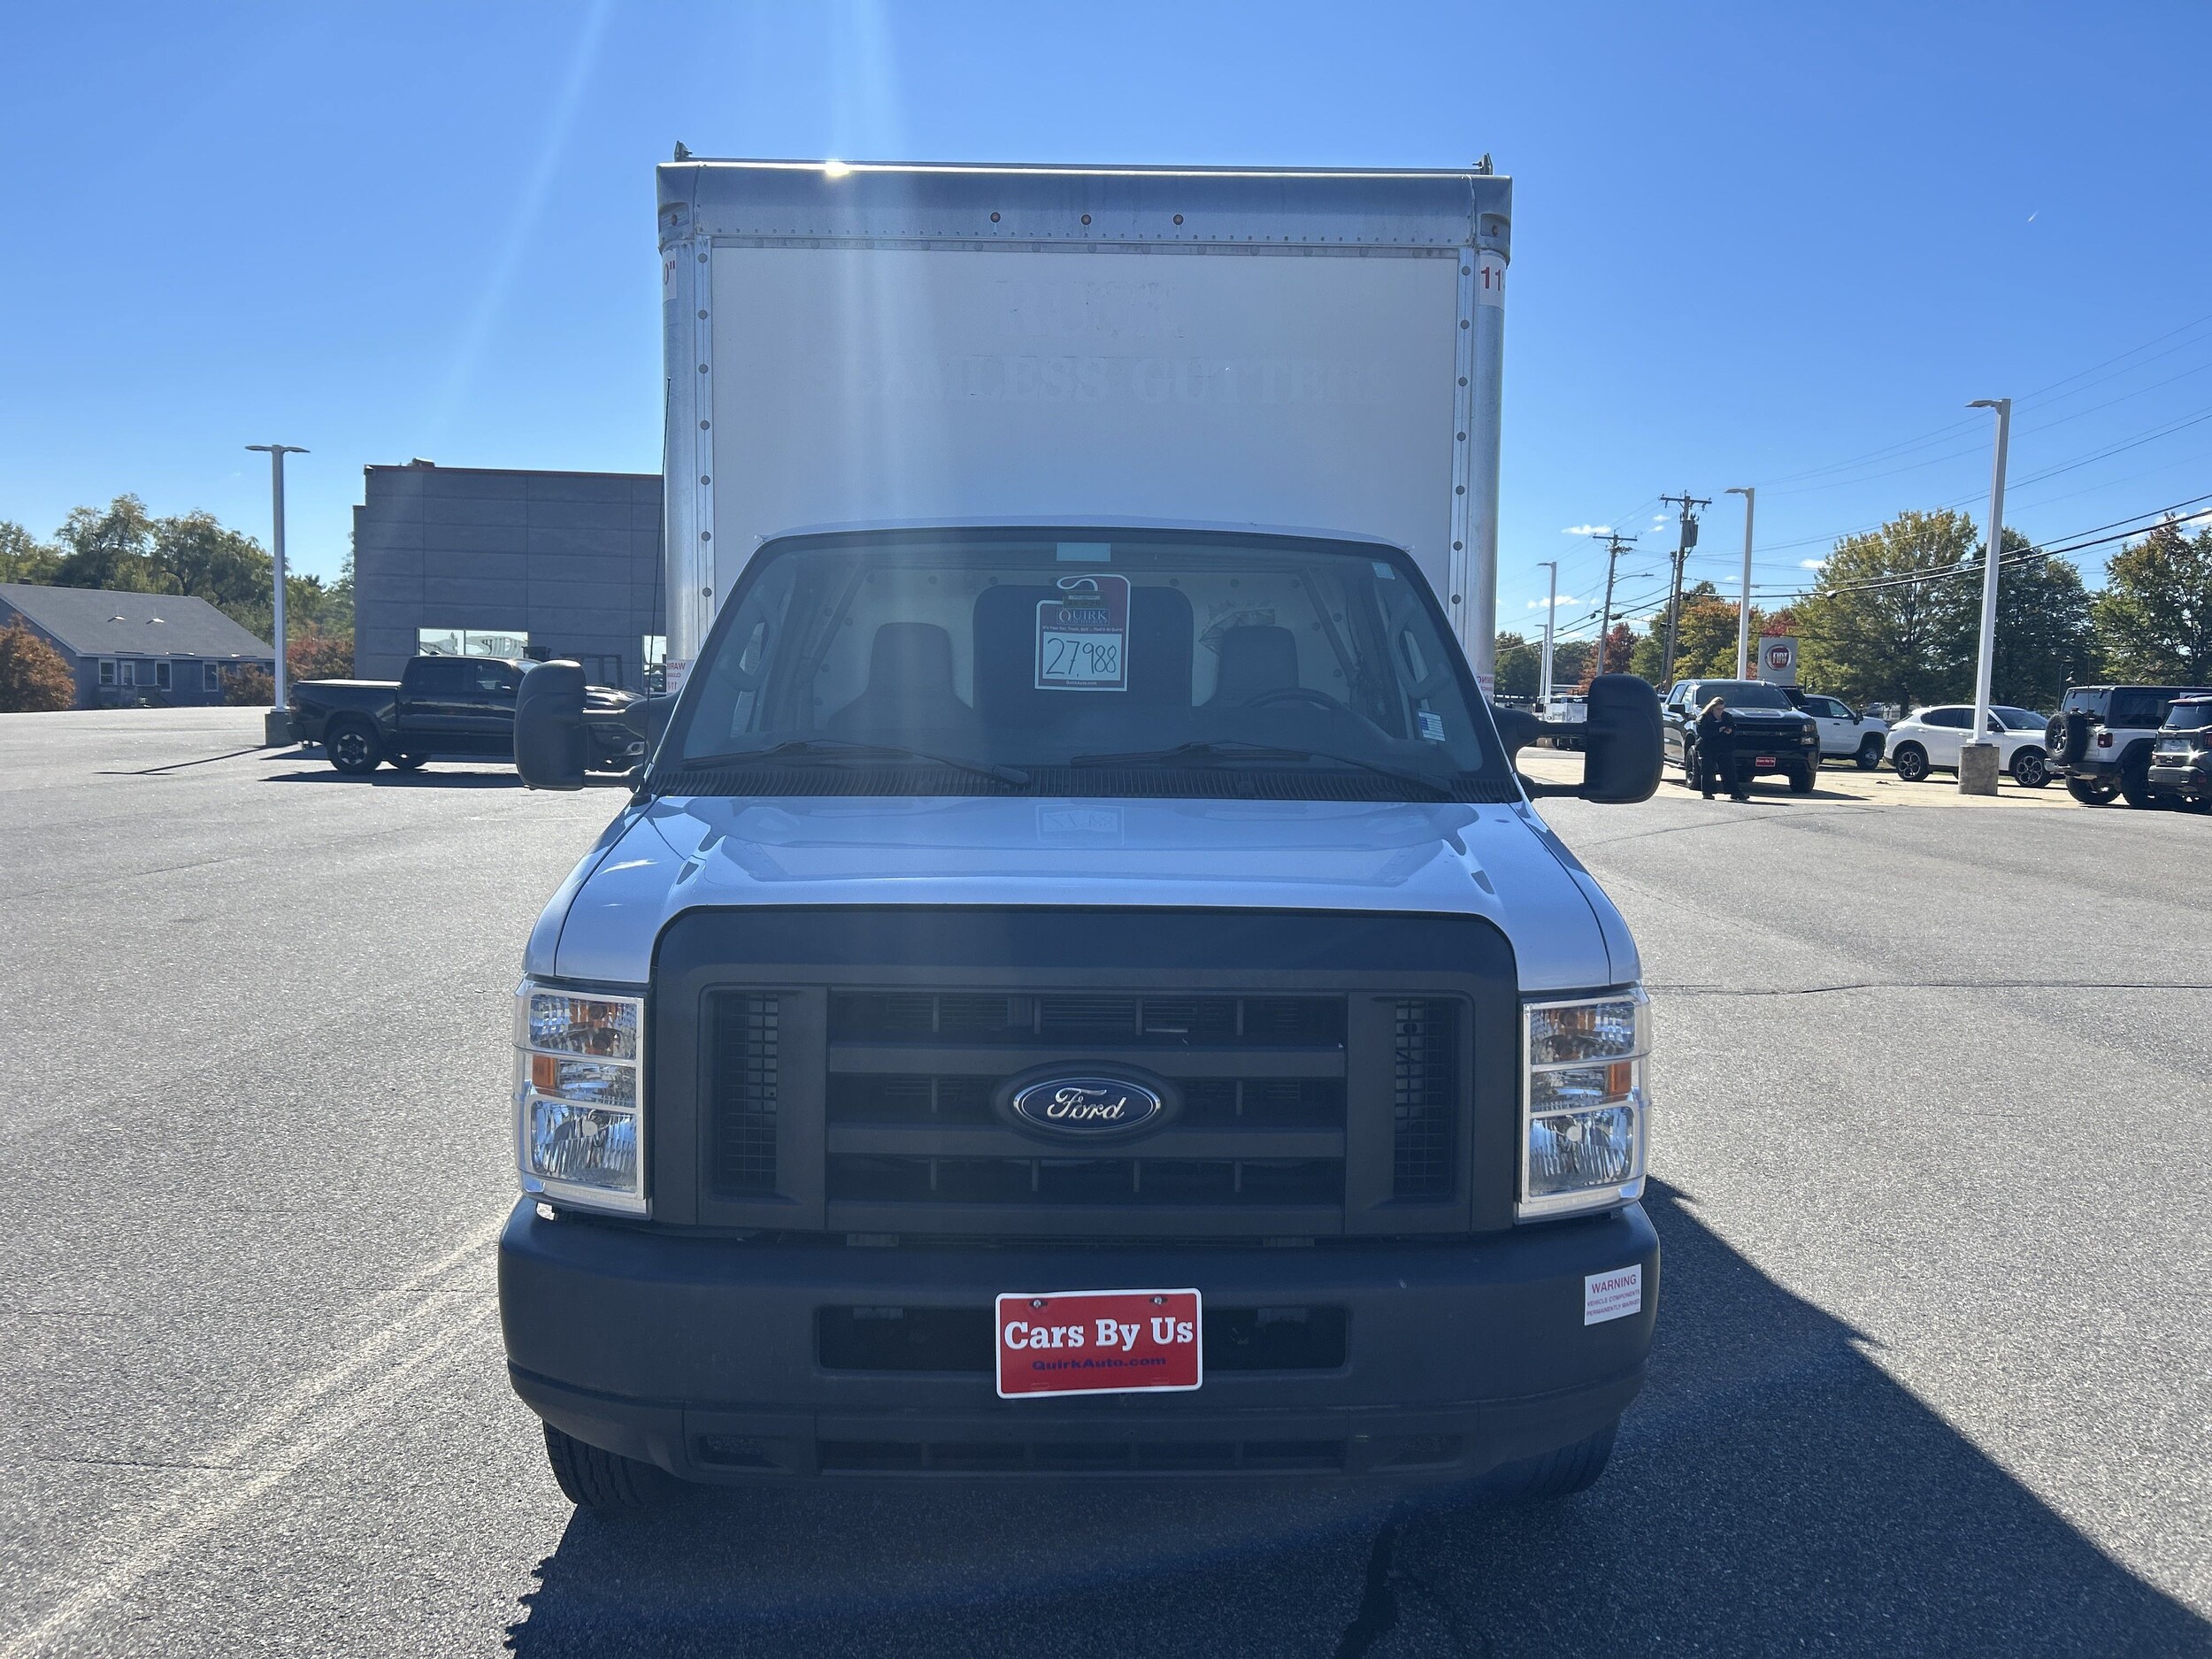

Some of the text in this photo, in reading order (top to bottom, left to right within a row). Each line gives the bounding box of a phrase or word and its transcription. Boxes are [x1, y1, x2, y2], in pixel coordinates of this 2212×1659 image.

[1059, 609, 1107, 623] QUIRK
[1772, 652, 1788, 664] FIAT
[1047, 1087, 1126, 1121] Ford
[1592, 1274, 1637, 1294] WARNING
[1003, 1317, 1194, 1352] Cars By Us
[1032, 1356, 1167, 1371] QuirkAuto.com
